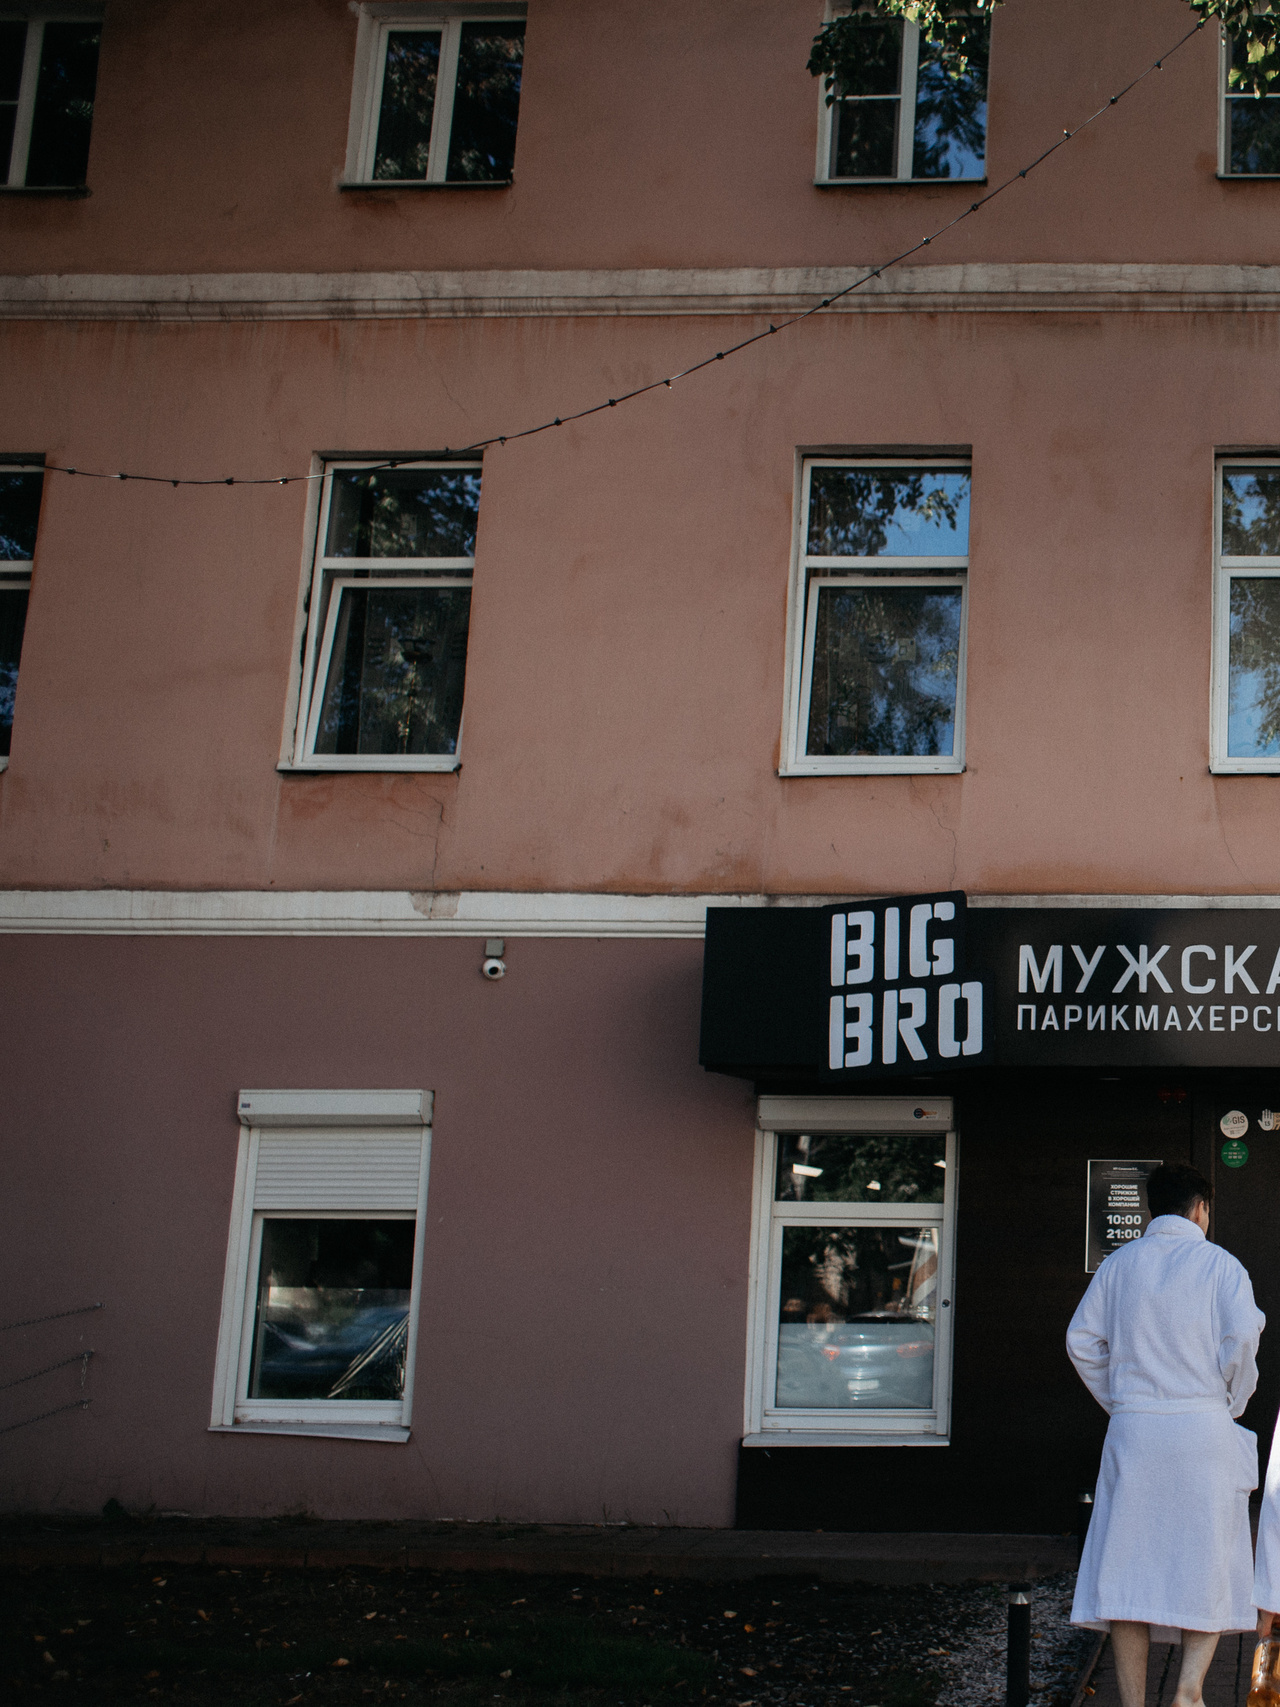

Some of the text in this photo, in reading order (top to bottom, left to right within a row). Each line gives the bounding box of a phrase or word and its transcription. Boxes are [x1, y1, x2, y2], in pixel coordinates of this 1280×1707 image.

[830, 901, 956, 987] BIG
[829, 981, 983, 1070] BRO
[1106, 1214, 1142, 1225] 10:00
[1106, 1228, 1141, 1239] 21:00
